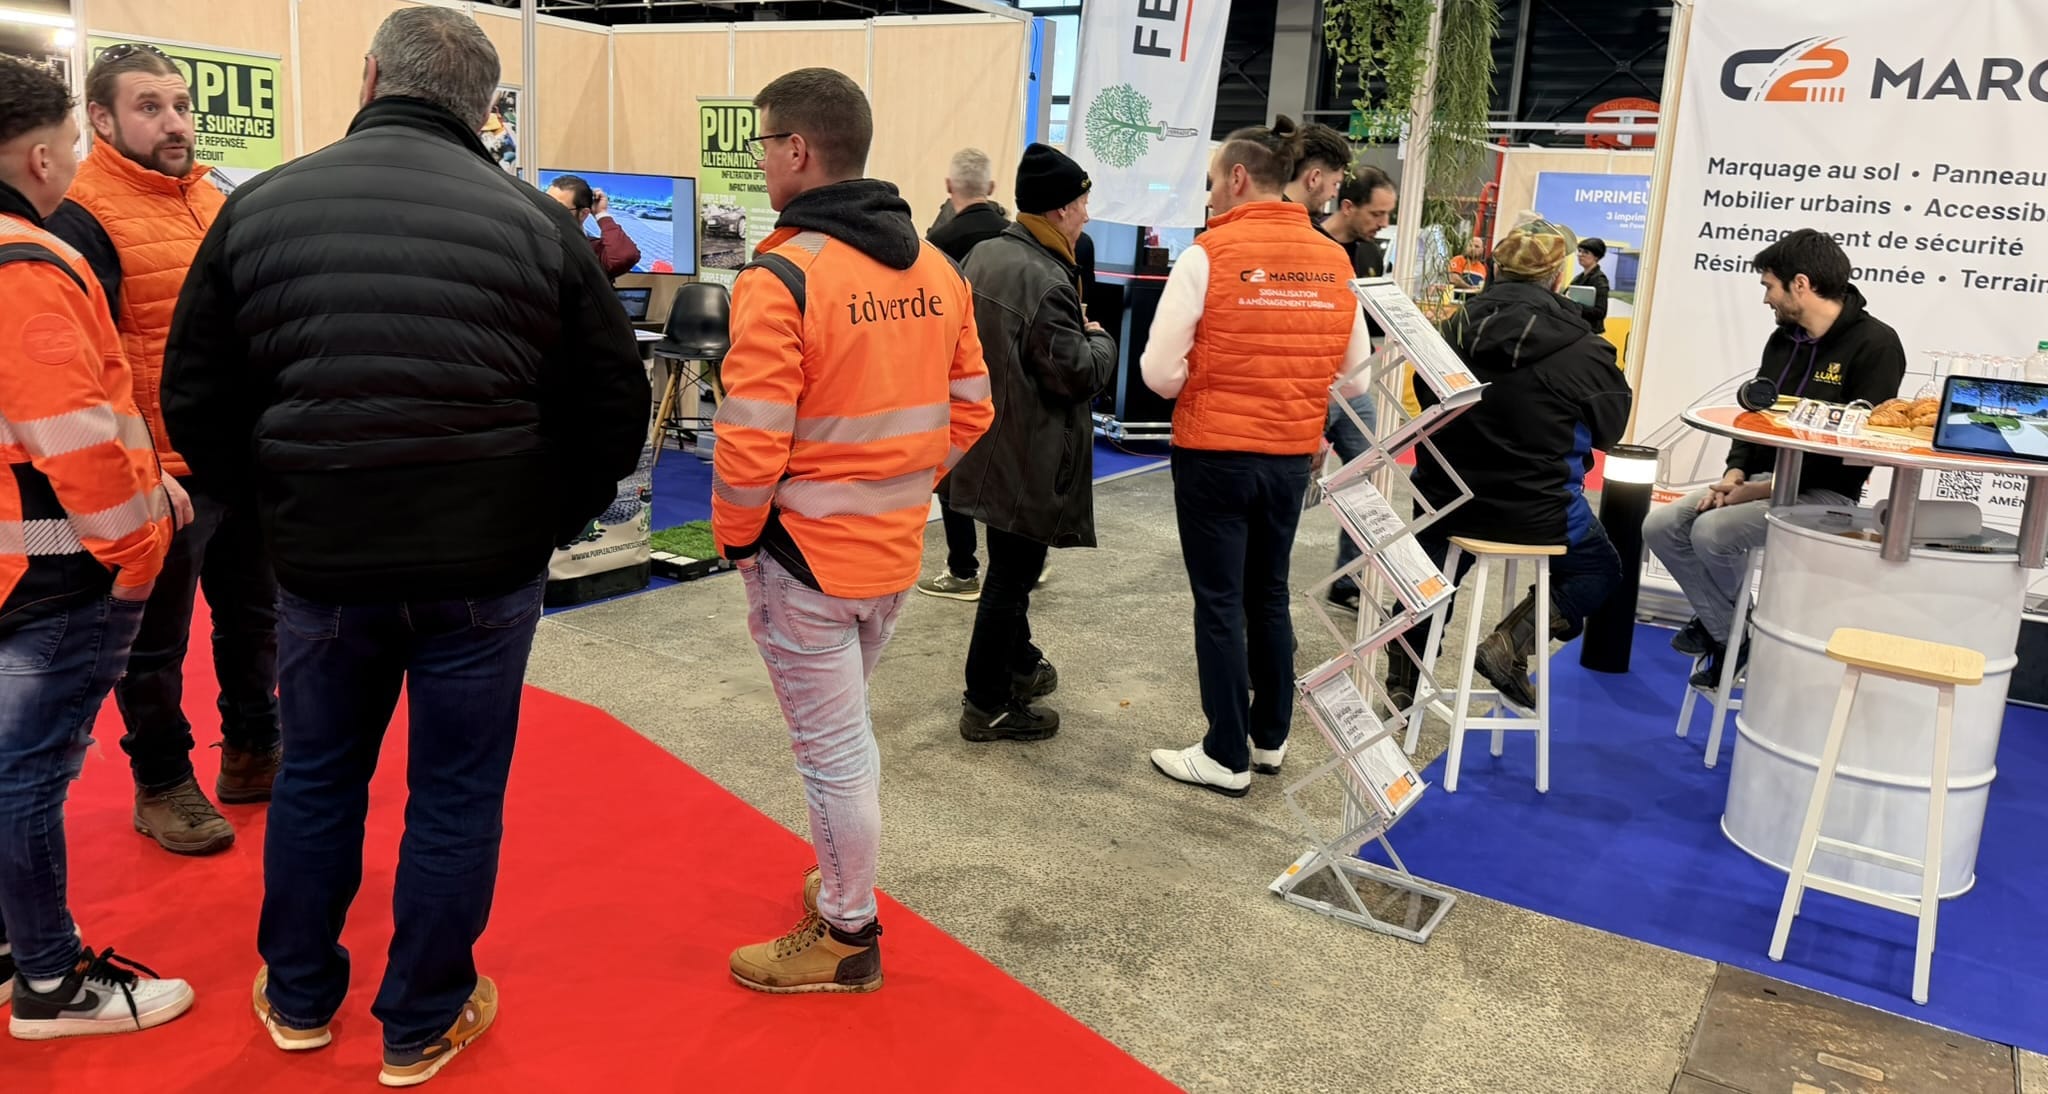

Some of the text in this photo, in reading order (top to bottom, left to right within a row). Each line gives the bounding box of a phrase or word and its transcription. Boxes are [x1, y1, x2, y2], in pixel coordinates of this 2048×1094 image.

[206, 115, 271, 136] SURFACE
[1708, 157, 2048, 187] Marquage au sol Panneau
[1606, 212, 1614, 220] 3
[1703, 189, 2048, 222] Mobilier urbains Accessib
[1878, 230, 1908, 250] de
[1914, 232, 2024, 256] sécurité
[1693, 252, 1764, 274] Résin
[1269, 272, 1337, 283] MARQUAGE
[1258, 288, 1318, 298] SIGNALISATION
[846, 287, 944, 325] idverde
